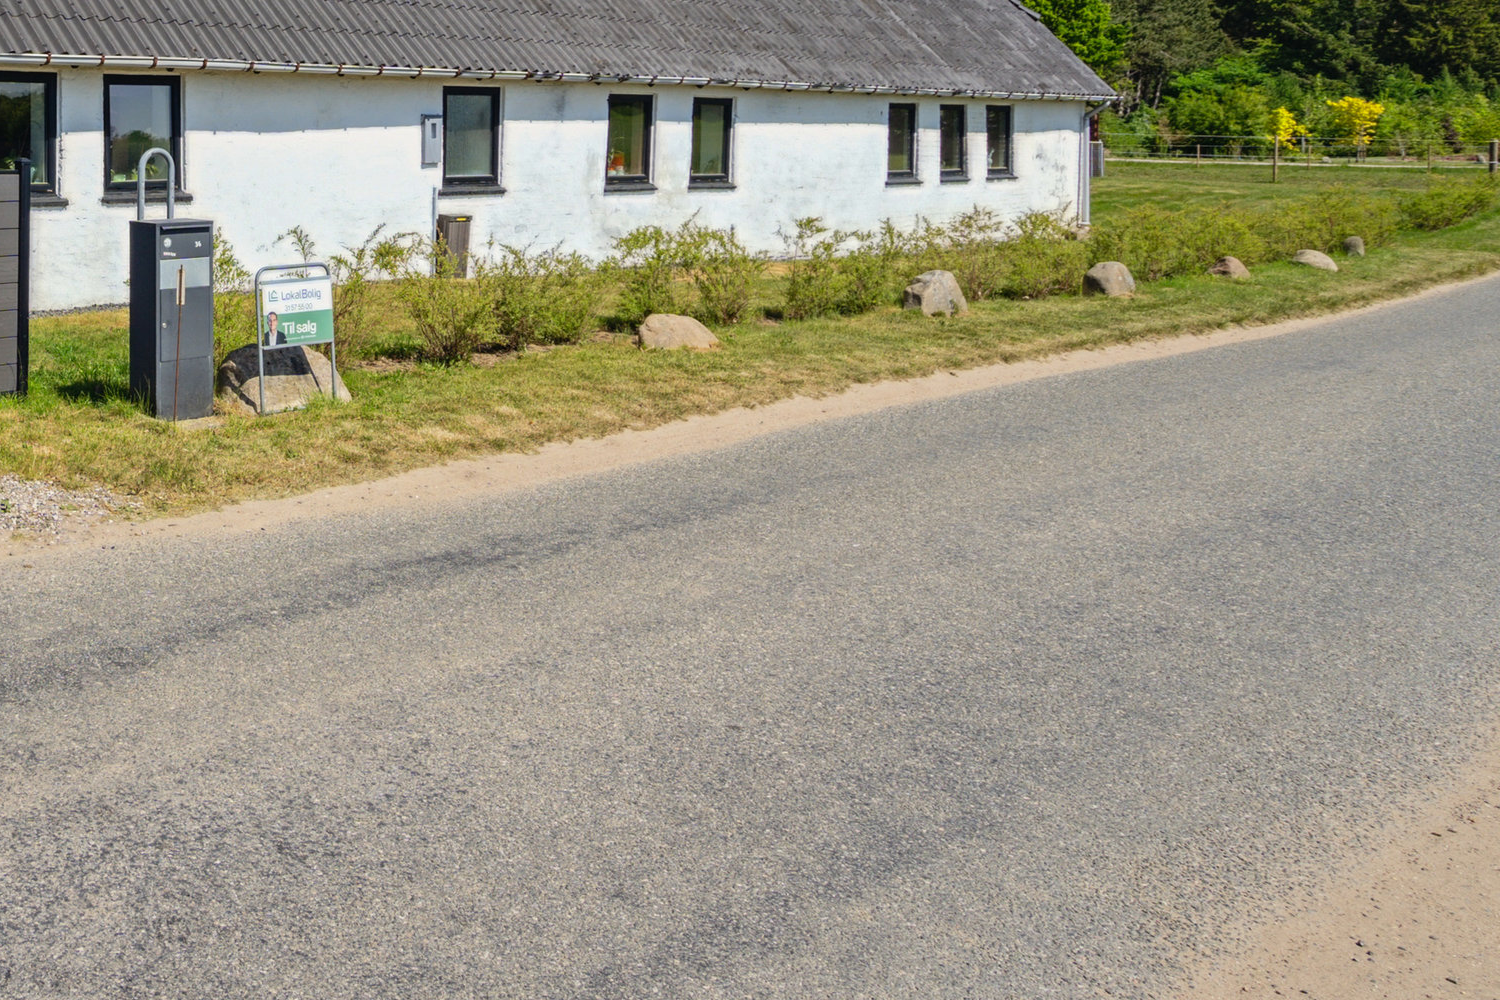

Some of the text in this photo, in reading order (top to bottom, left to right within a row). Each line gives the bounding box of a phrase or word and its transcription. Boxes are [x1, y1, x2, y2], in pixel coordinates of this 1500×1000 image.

[281, 289, 321, 300] LokalBolig
[282, 320, 317, 335] Til salg
